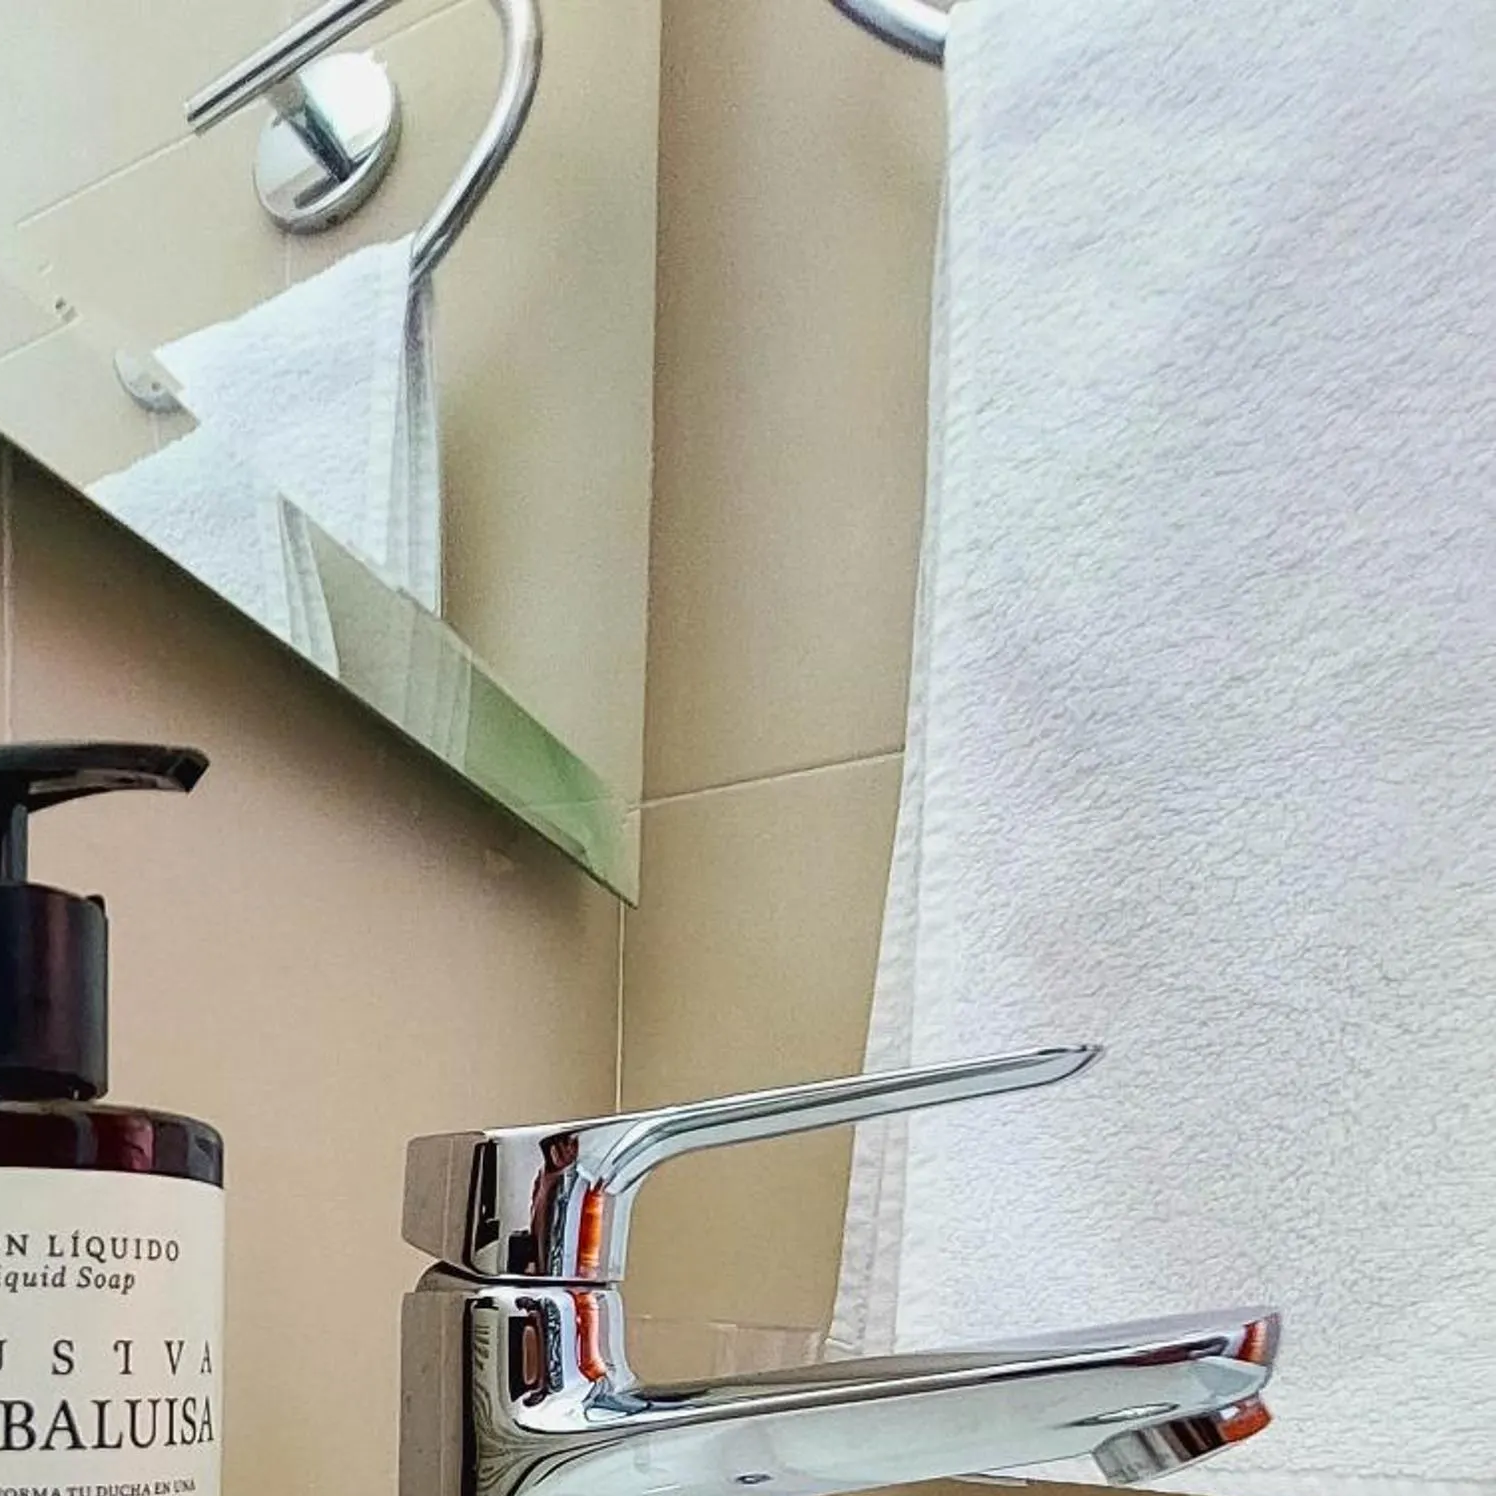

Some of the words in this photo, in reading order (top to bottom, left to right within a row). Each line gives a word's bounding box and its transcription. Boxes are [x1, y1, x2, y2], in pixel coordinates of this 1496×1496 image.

[47, 1230, 180, 1263] LÍQUIDO
[76, 1266, 137, 1296] Soap
[154, 1481, 170, 1495] EN
